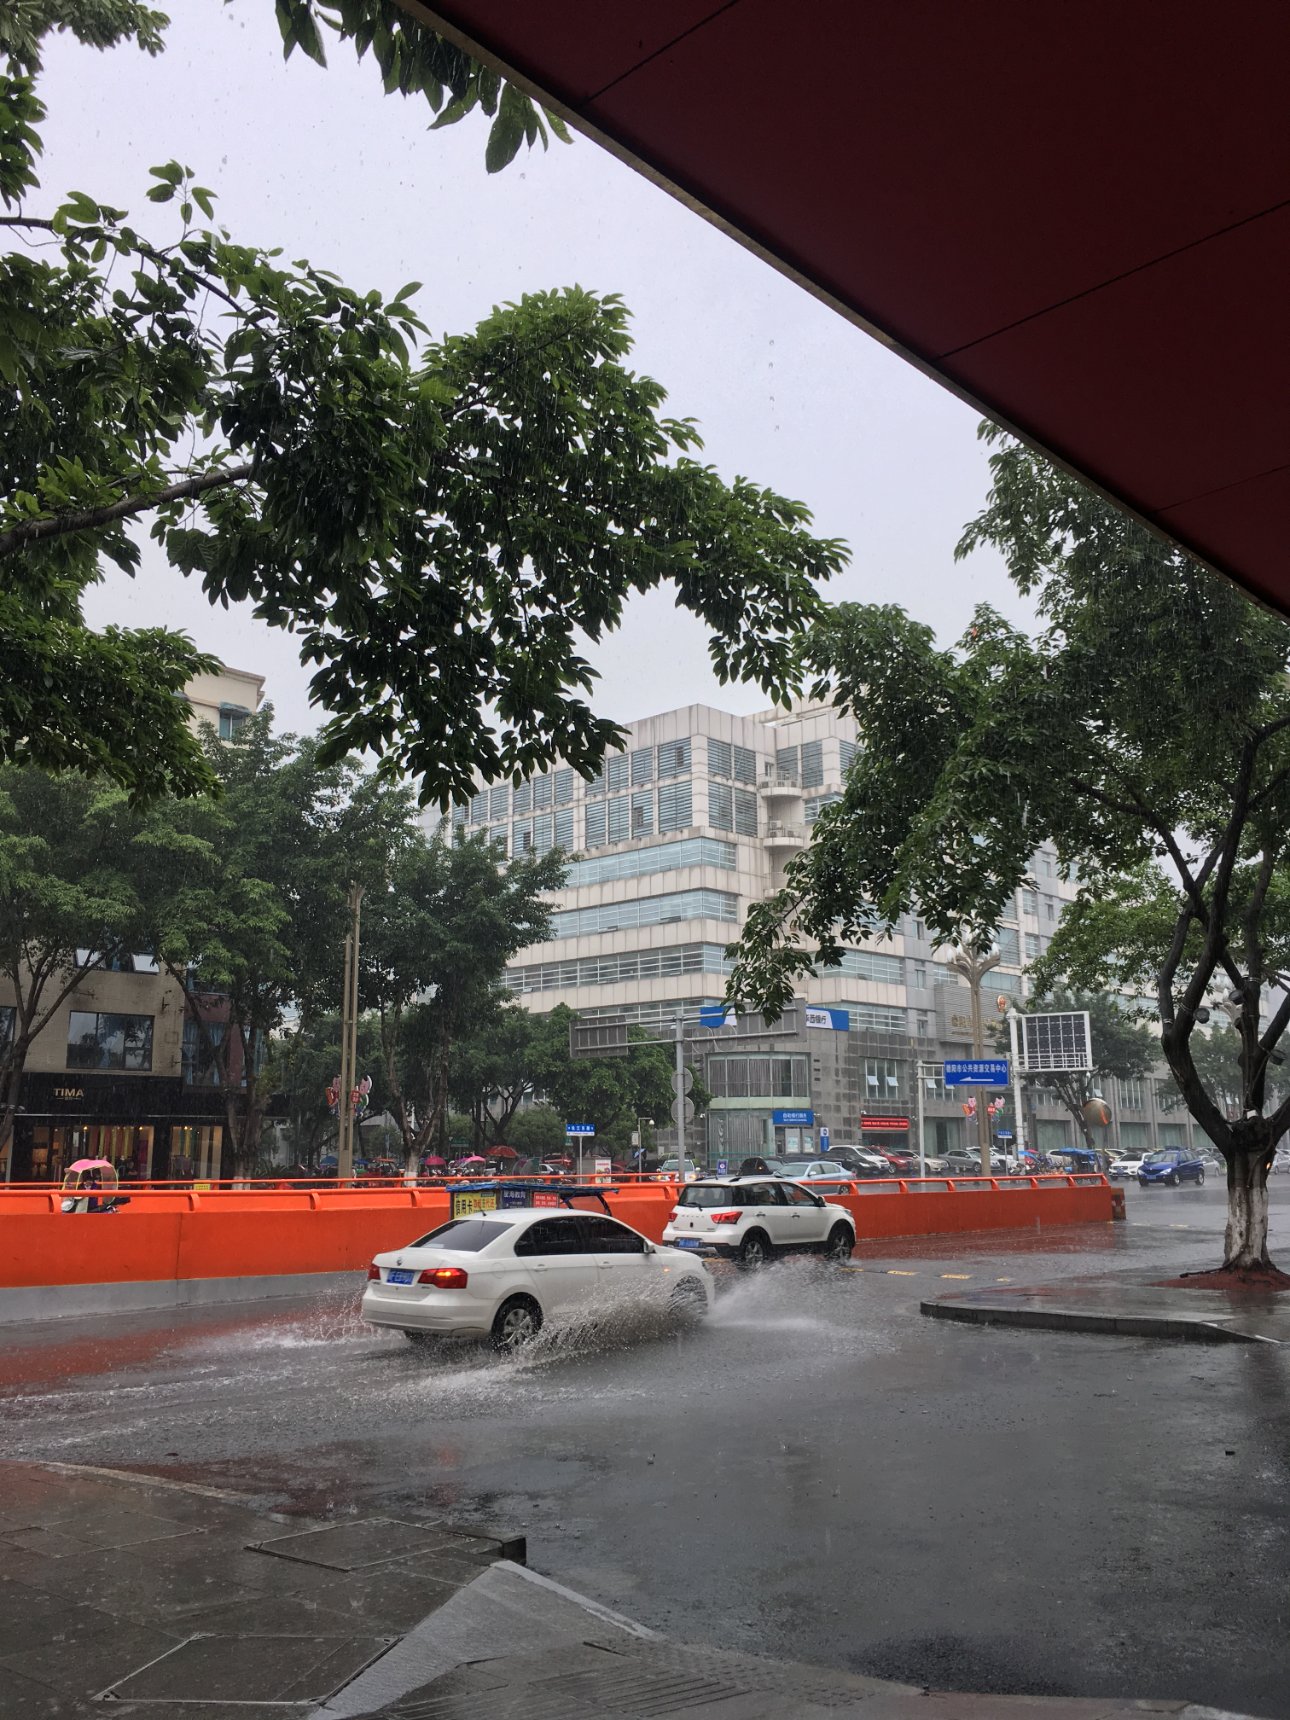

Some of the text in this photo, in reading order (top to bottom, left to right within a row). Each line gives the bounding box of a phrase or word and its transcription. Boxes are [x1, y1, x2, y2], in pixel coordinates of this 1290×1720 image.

[946, 1064, 1007, 1073] 德阳市公共资源交易中心
[53, 1088, 84, 1097] TIMA
